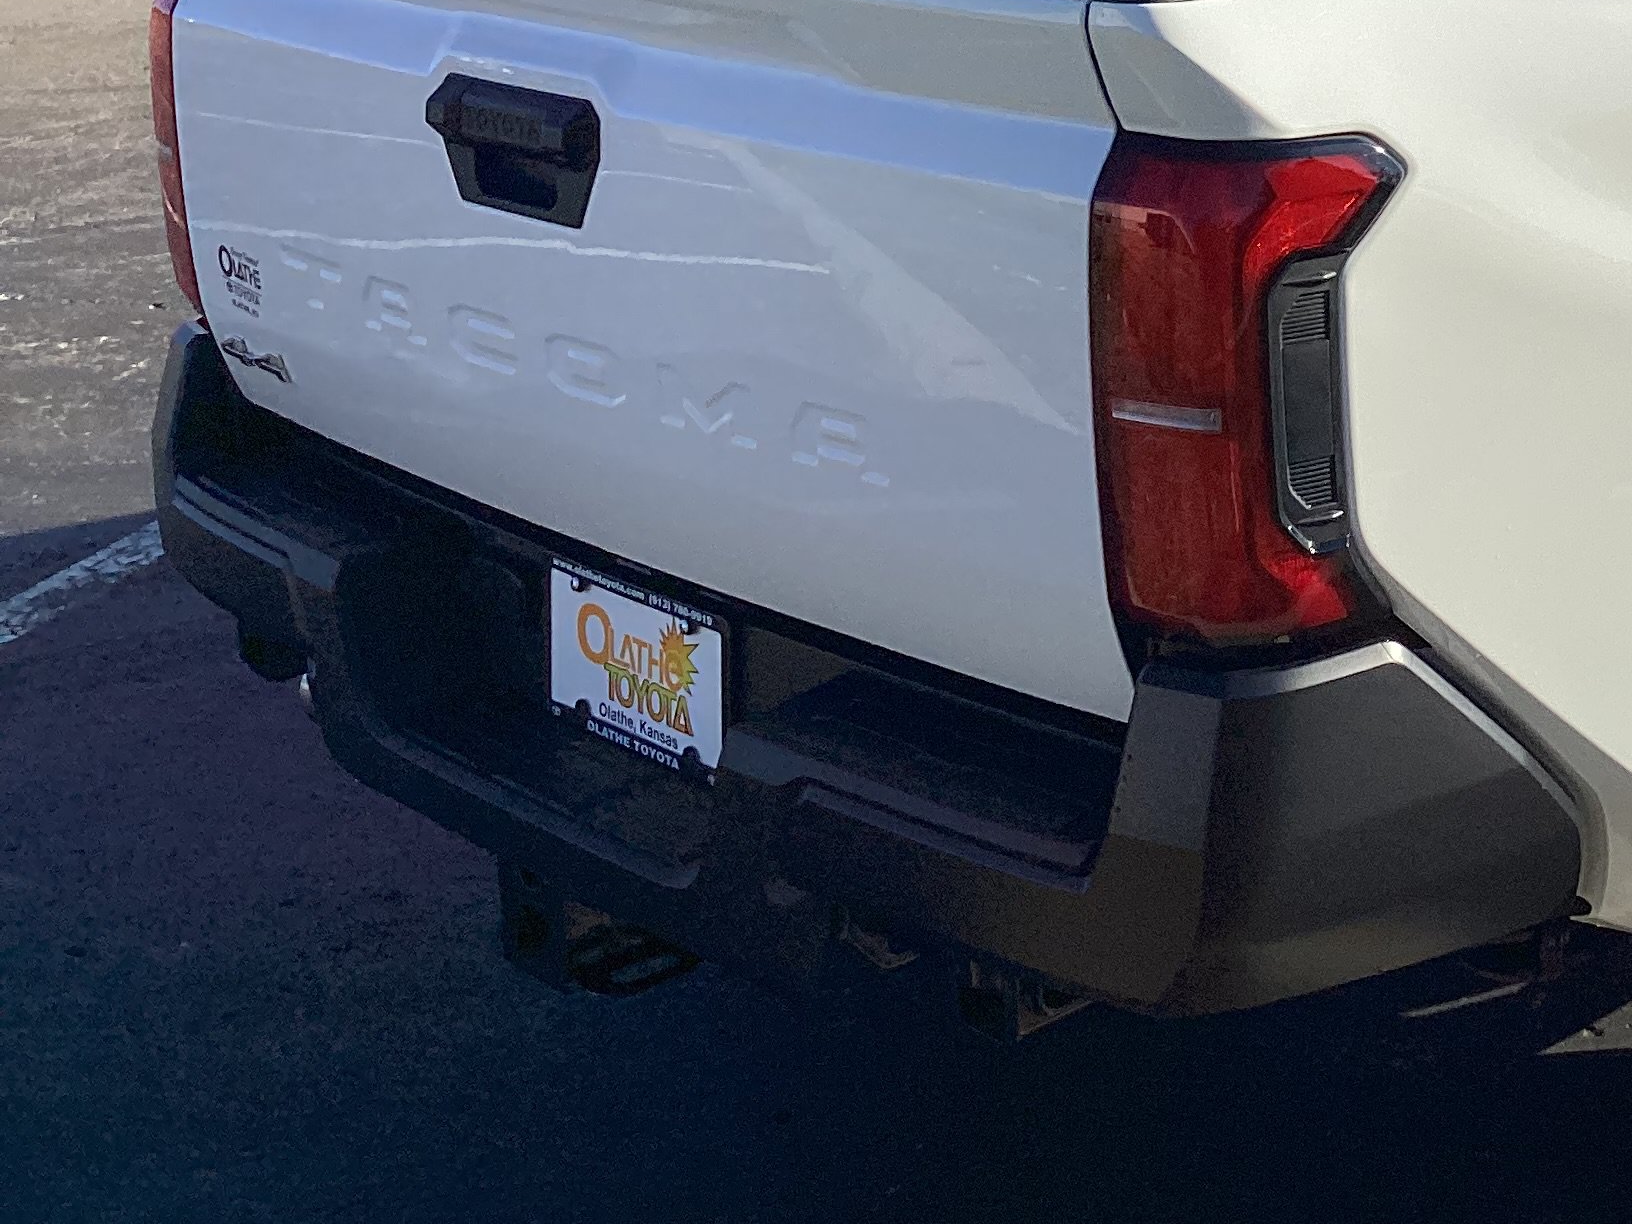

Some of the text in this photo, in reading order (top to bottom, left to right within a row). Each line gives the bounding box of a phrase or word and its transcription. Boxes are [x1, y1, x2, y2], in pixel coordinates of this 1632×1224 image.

[576, 602, 684, 693] OLATHE
[599, 702, 679, 750] Olathe, Kansas
[604, 662, 694, 736] TOYOTA
[587, 719, 680, 771] OLATHE TOYOTA
